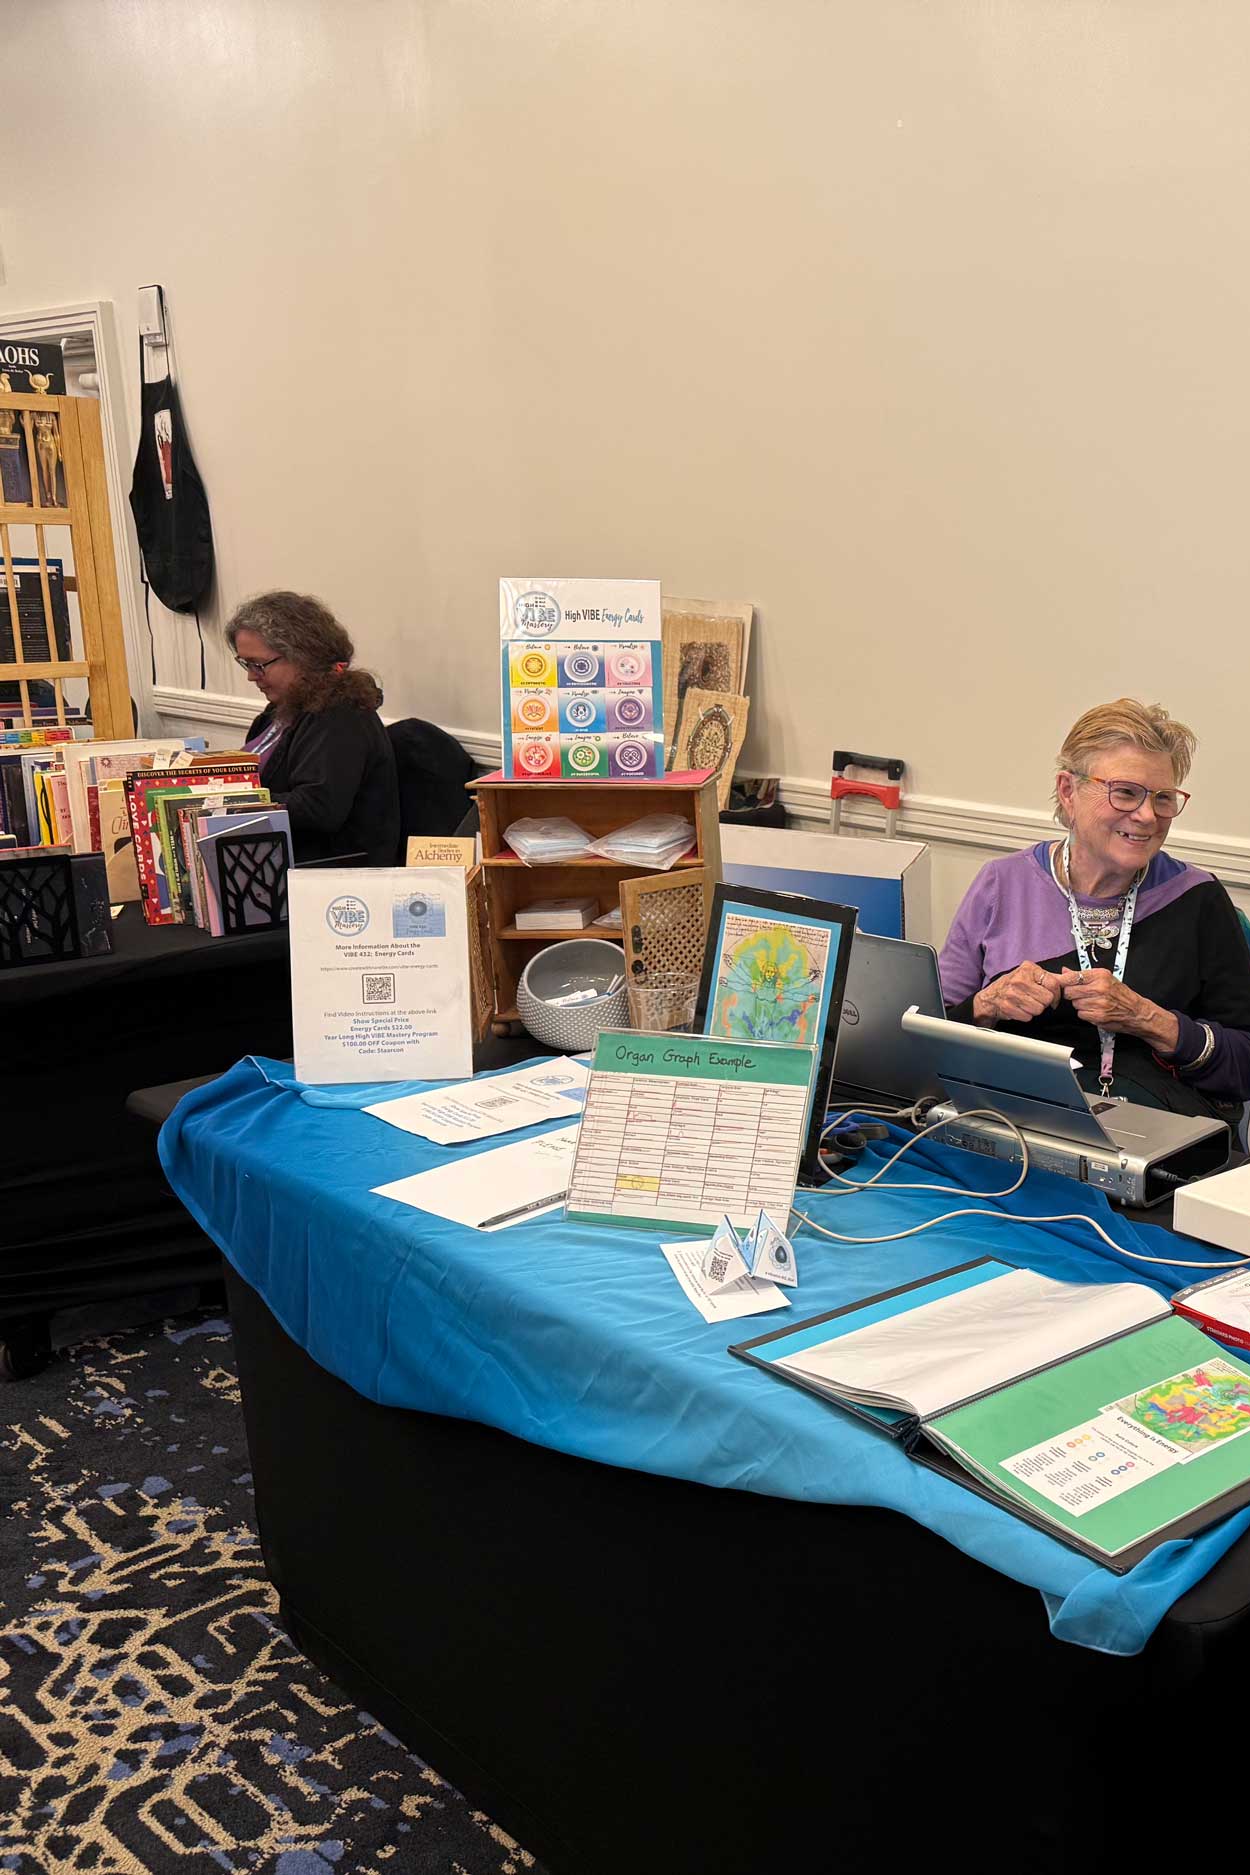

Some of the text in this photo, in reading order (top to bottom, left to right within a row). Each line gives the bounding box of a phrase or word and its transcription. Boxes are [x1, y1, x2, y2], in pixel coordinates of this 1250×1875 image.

[564, 610, 580, 622] High
[582, 609, 600, 620] VIBE
[128, 794, 147, 881] LOVE CARDS
[414, 849, 462, 863] Alchemy
[331, 910, 366, 923] VIBE
[374, 950, 396, 958] Energy
[615, 1045, 756, 1072] Organ Graph Example
[1116, 1416, 1150, 1438] Everything
[1156, 1440, 1178, 1454] Energy
